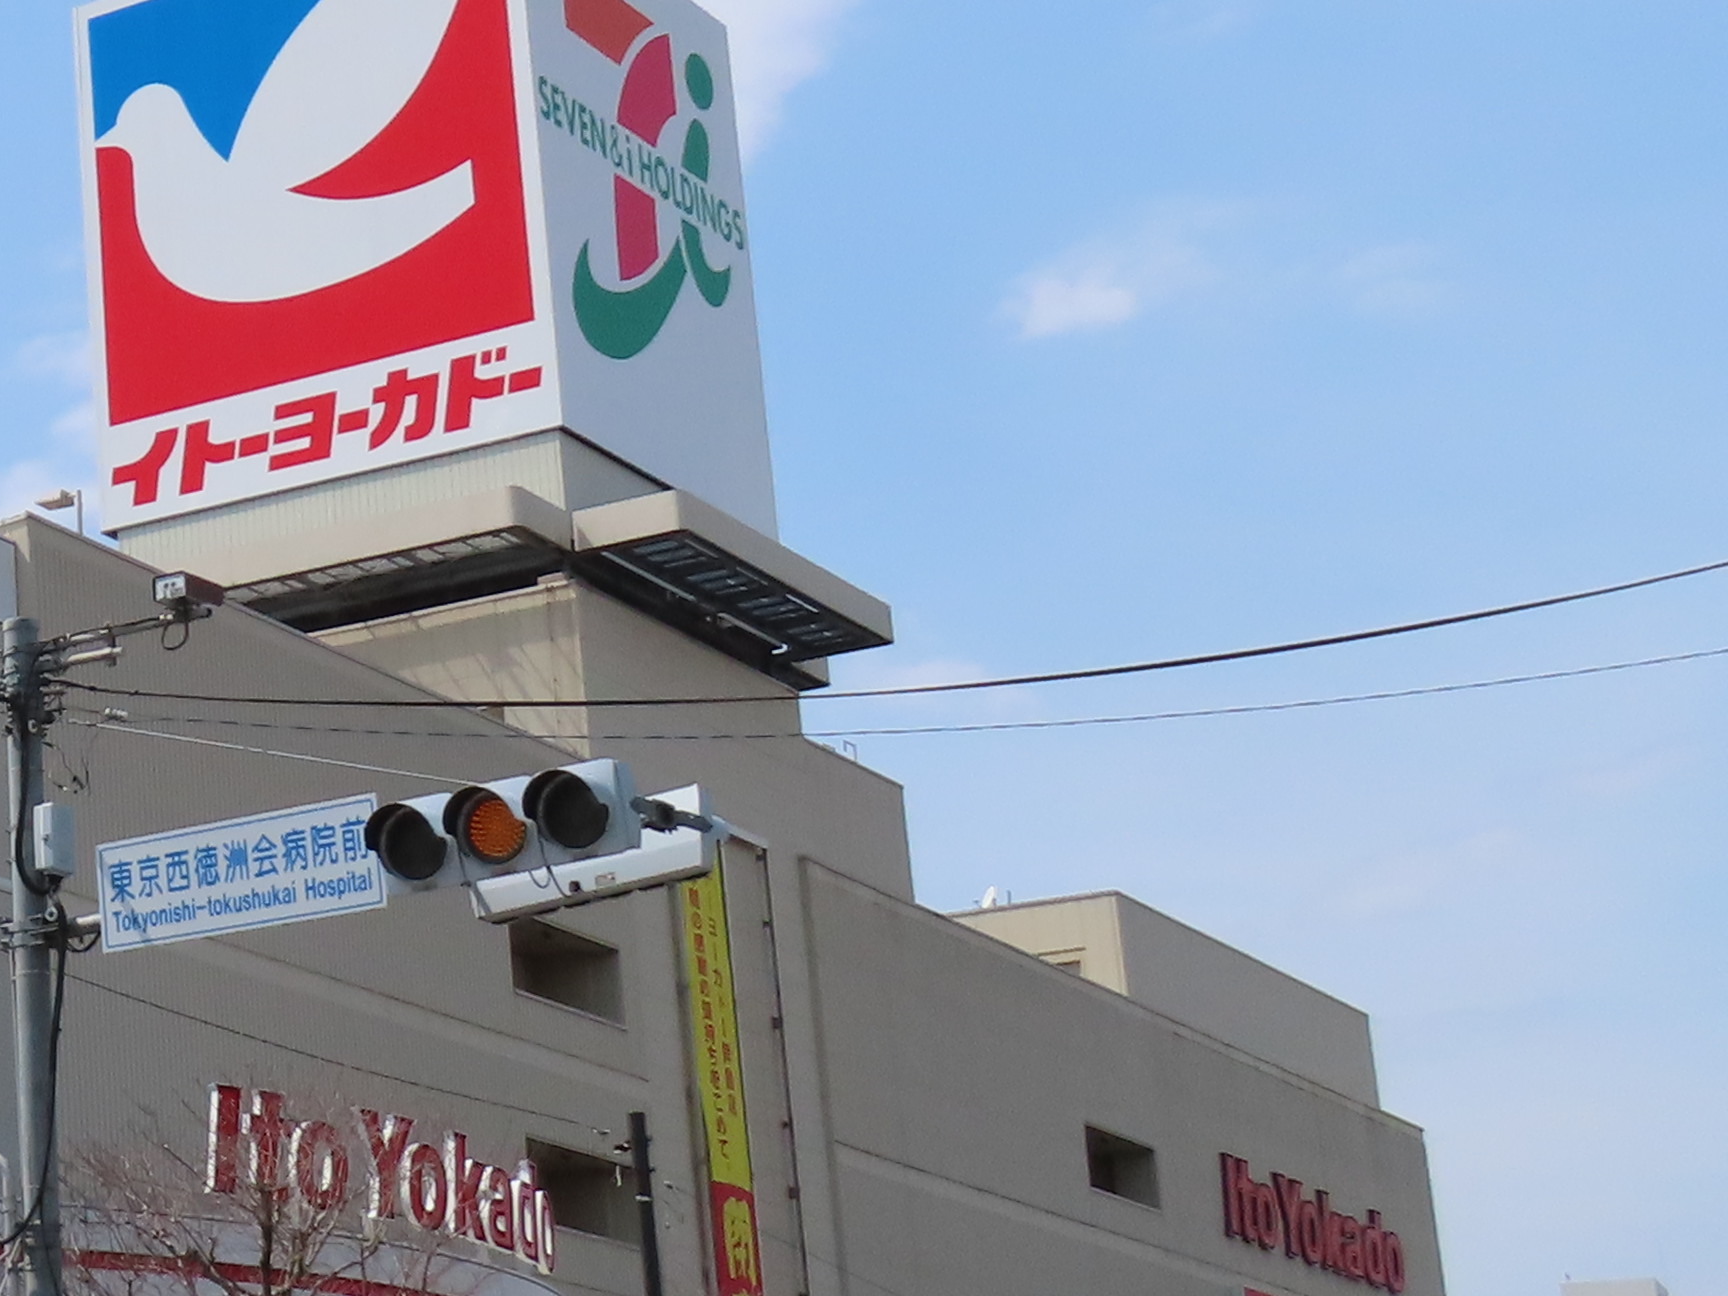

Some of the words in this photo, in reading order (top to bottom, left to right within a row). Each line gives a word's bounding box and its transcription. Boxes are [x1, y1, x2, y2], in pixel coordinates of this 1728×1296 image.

[640, 151, 744, 251] HOLDINGS
[111, 346, 542, 507] イトーヨーカドー
[108, 817, 368, 904] 東京西徳洲会病院前
[111, 884, 296, 933] Tokyonishi-tokushukai
[304, 867, 373, 902] Hospital
[205, 1083, 349, 1210] Ito
[1270, 1171, 1406, 1295] Yokado
